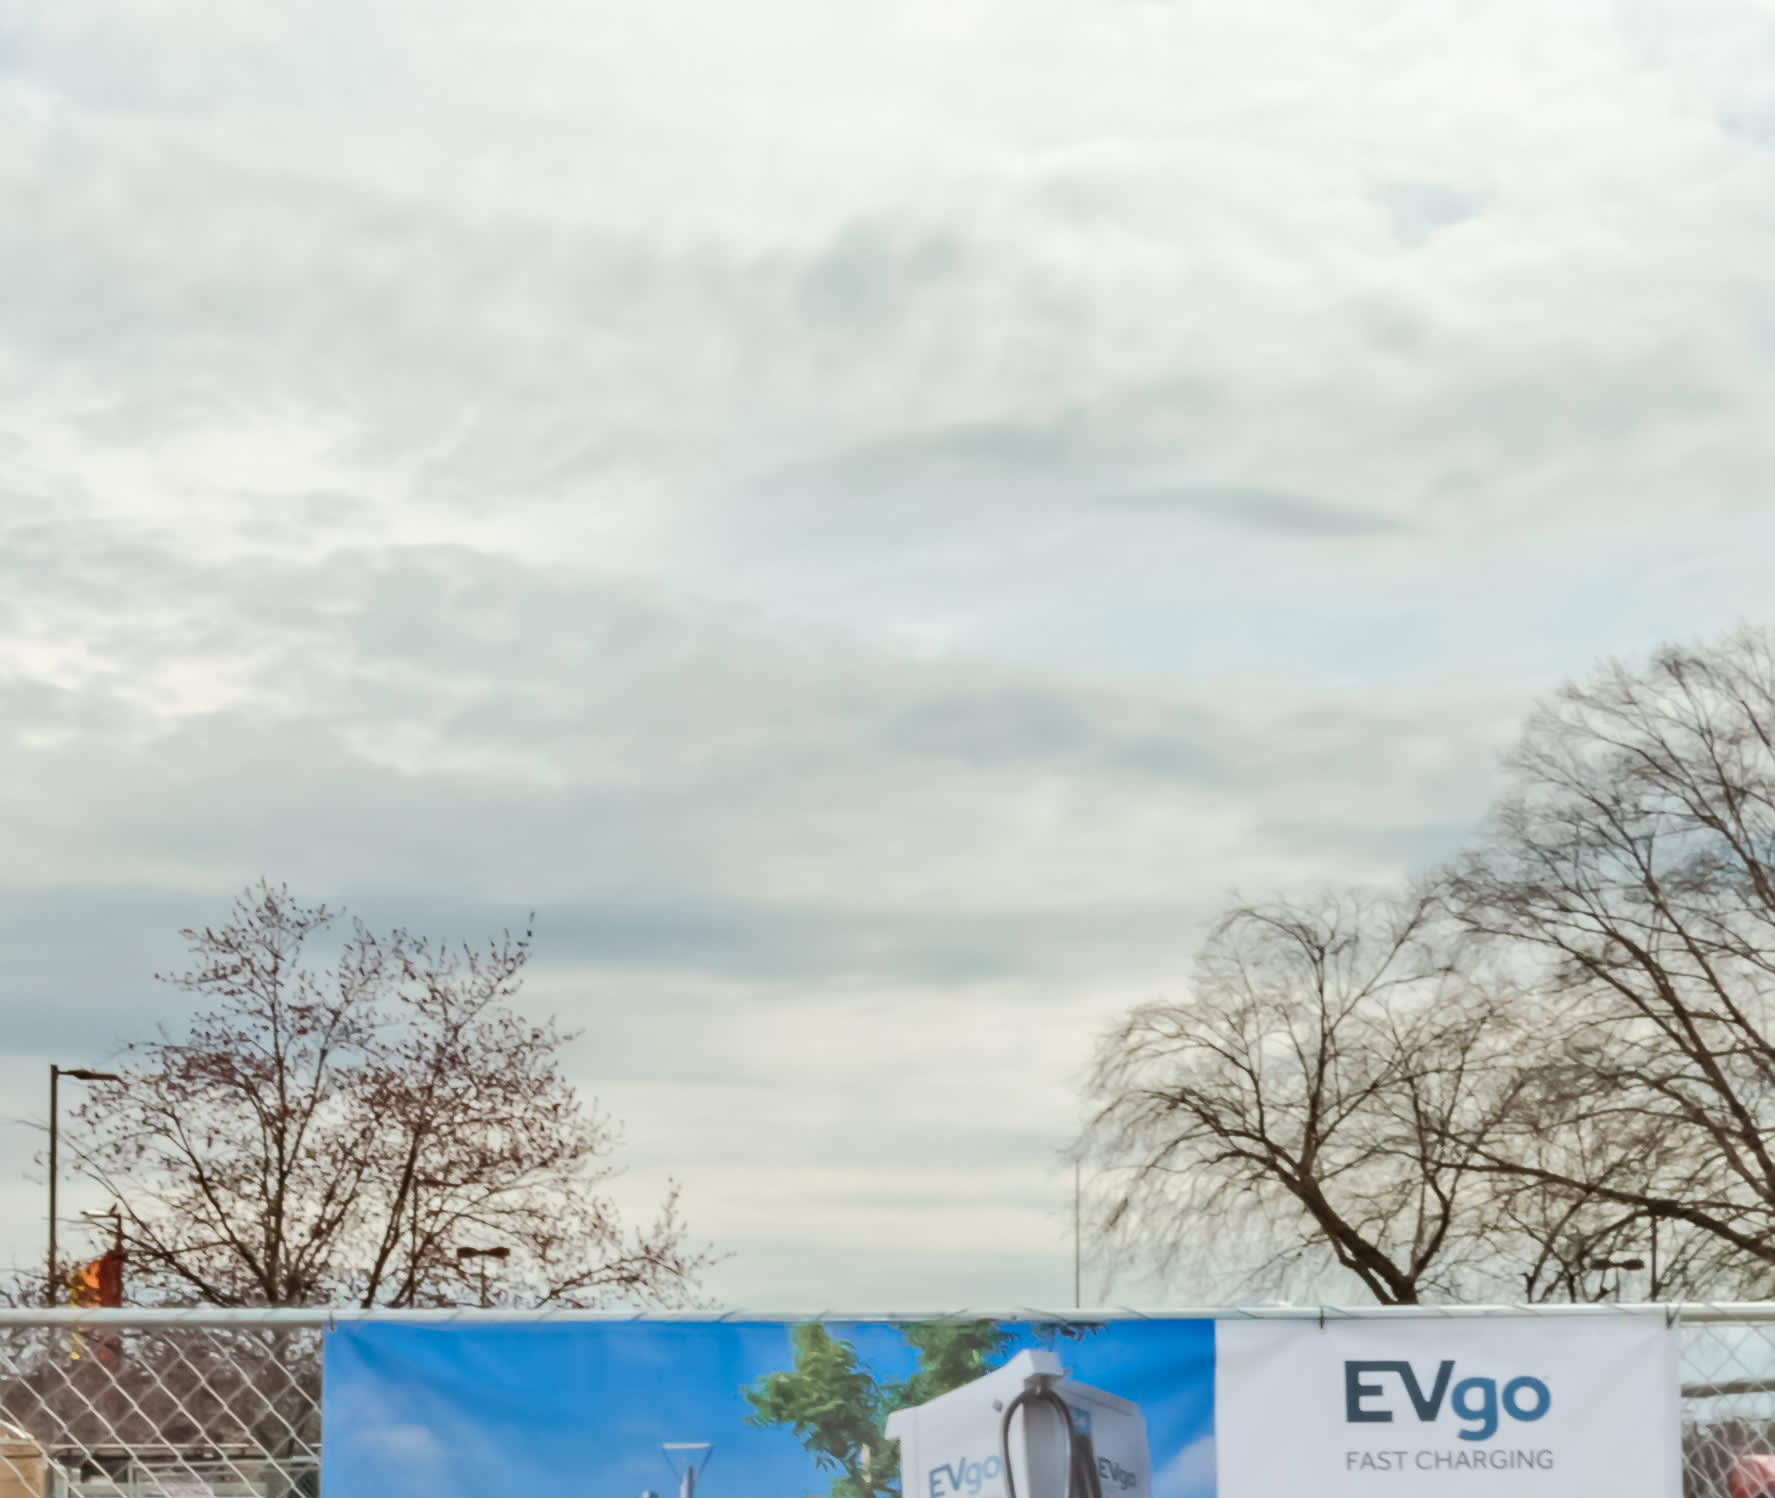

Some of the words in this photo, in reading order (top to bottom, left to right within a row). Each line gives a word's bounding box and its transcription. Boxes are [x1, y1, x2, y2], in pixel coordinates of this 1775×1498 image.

[1344, 1360, 1551, 1441] EVgo
[1098, 1457, 1137, 1490] EVgo
[1346, 1450, 1409, 1471] FAST
[1415, 1449, 1554, 1471] CHARGING
